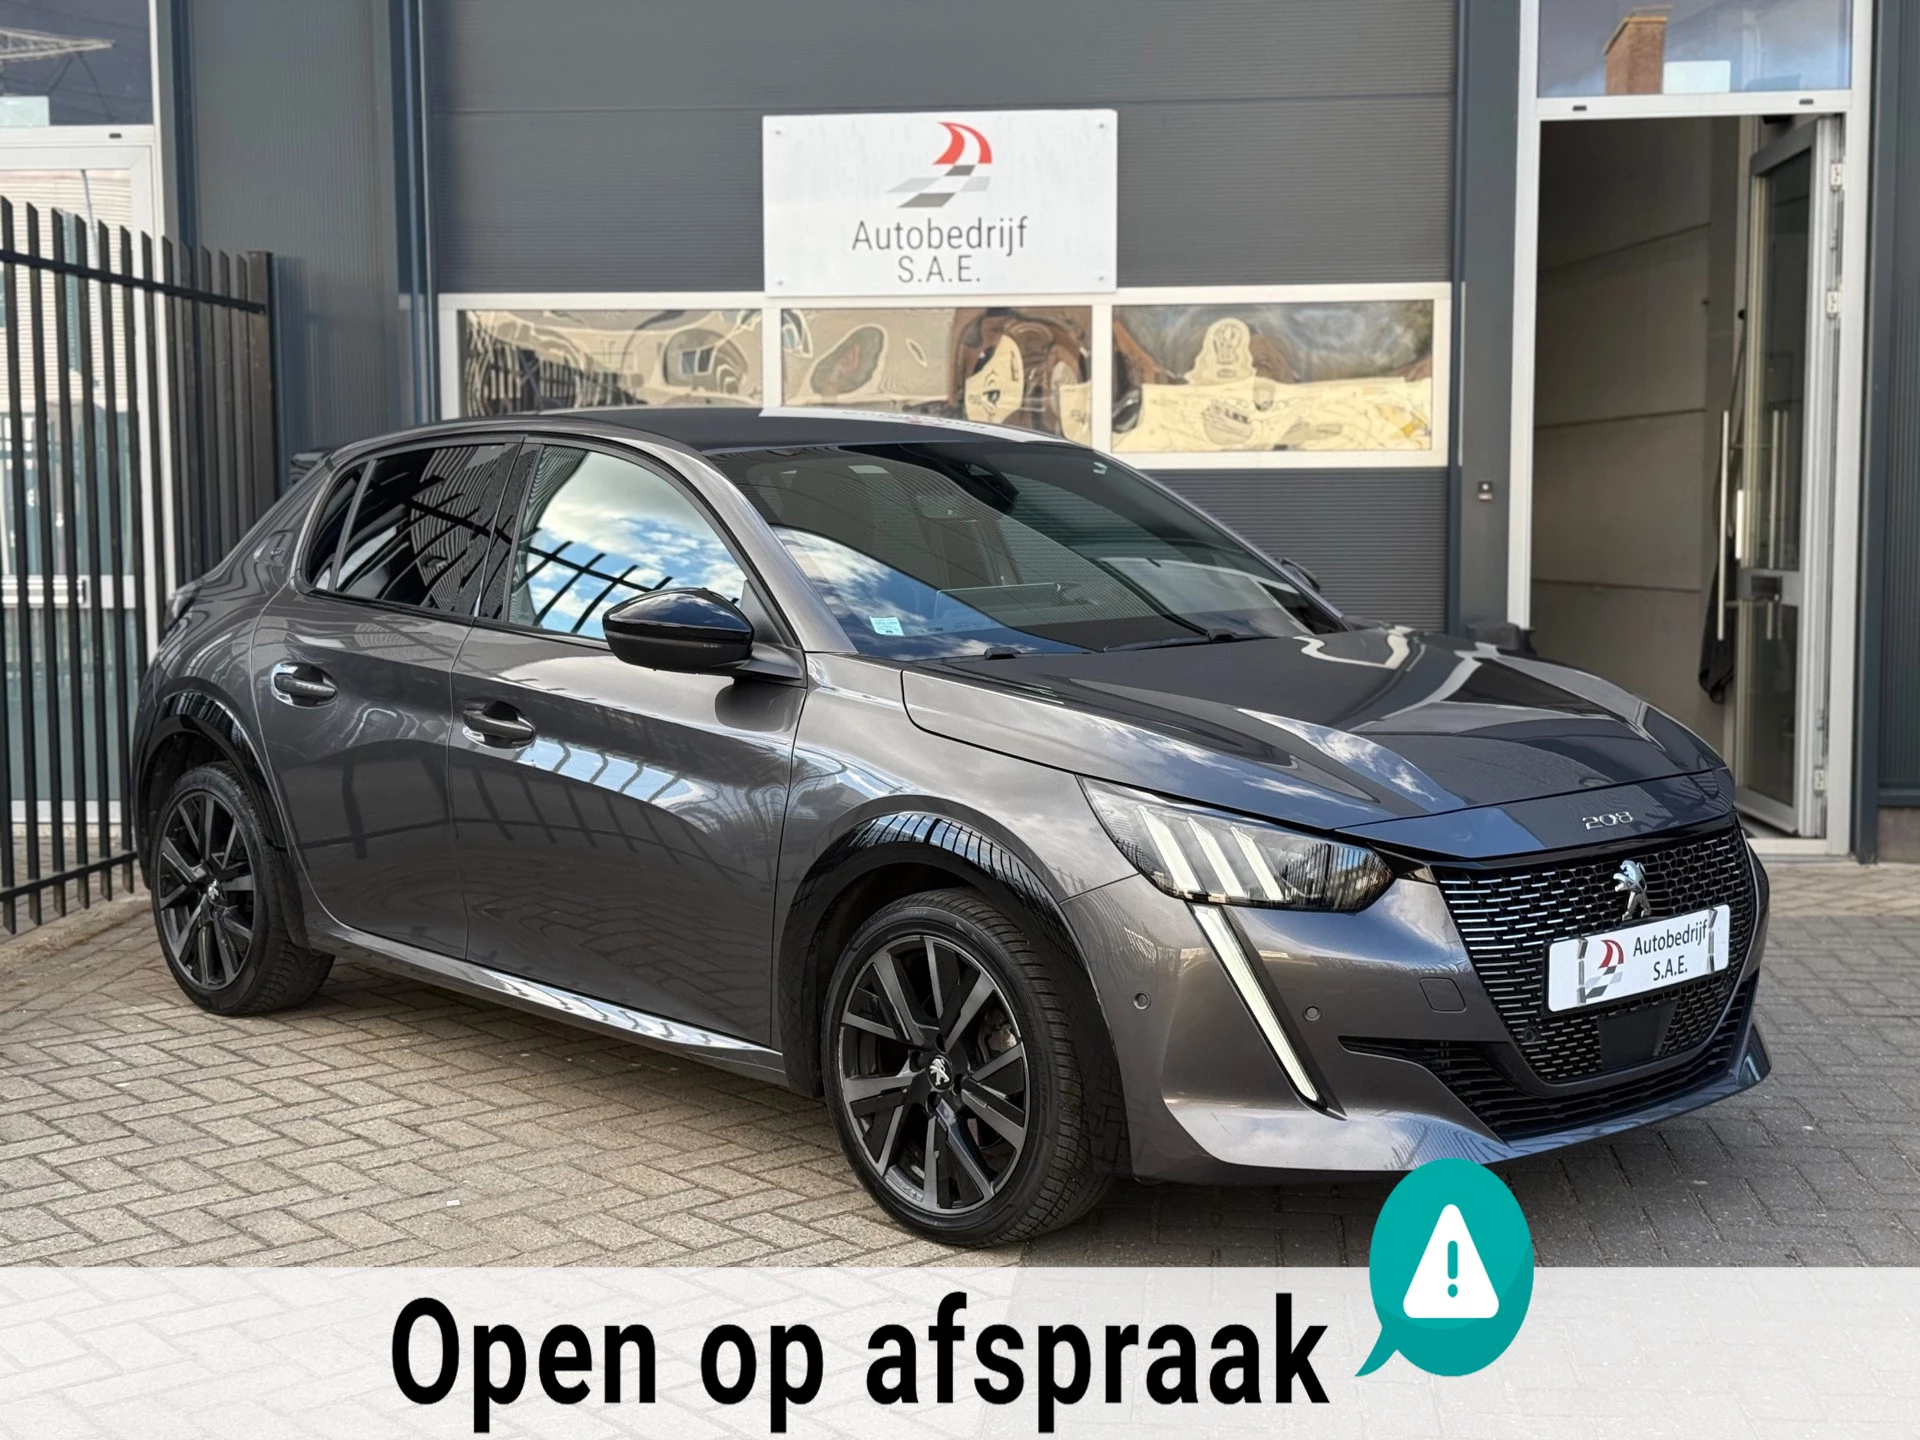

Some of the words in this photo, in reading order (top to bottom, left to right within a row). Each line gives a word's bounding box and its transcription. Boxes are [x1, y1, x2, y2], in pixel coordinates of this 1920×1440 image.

[852, 216, 1028, 257] Autobedrijf
[898, 254, 981, 283] S.A.E.
[1582, 811, 1633, 830] 208
[1633, 918, 1708, 957] Autobedrijf
[1653, 955, 1688, 981] S.A.E.
